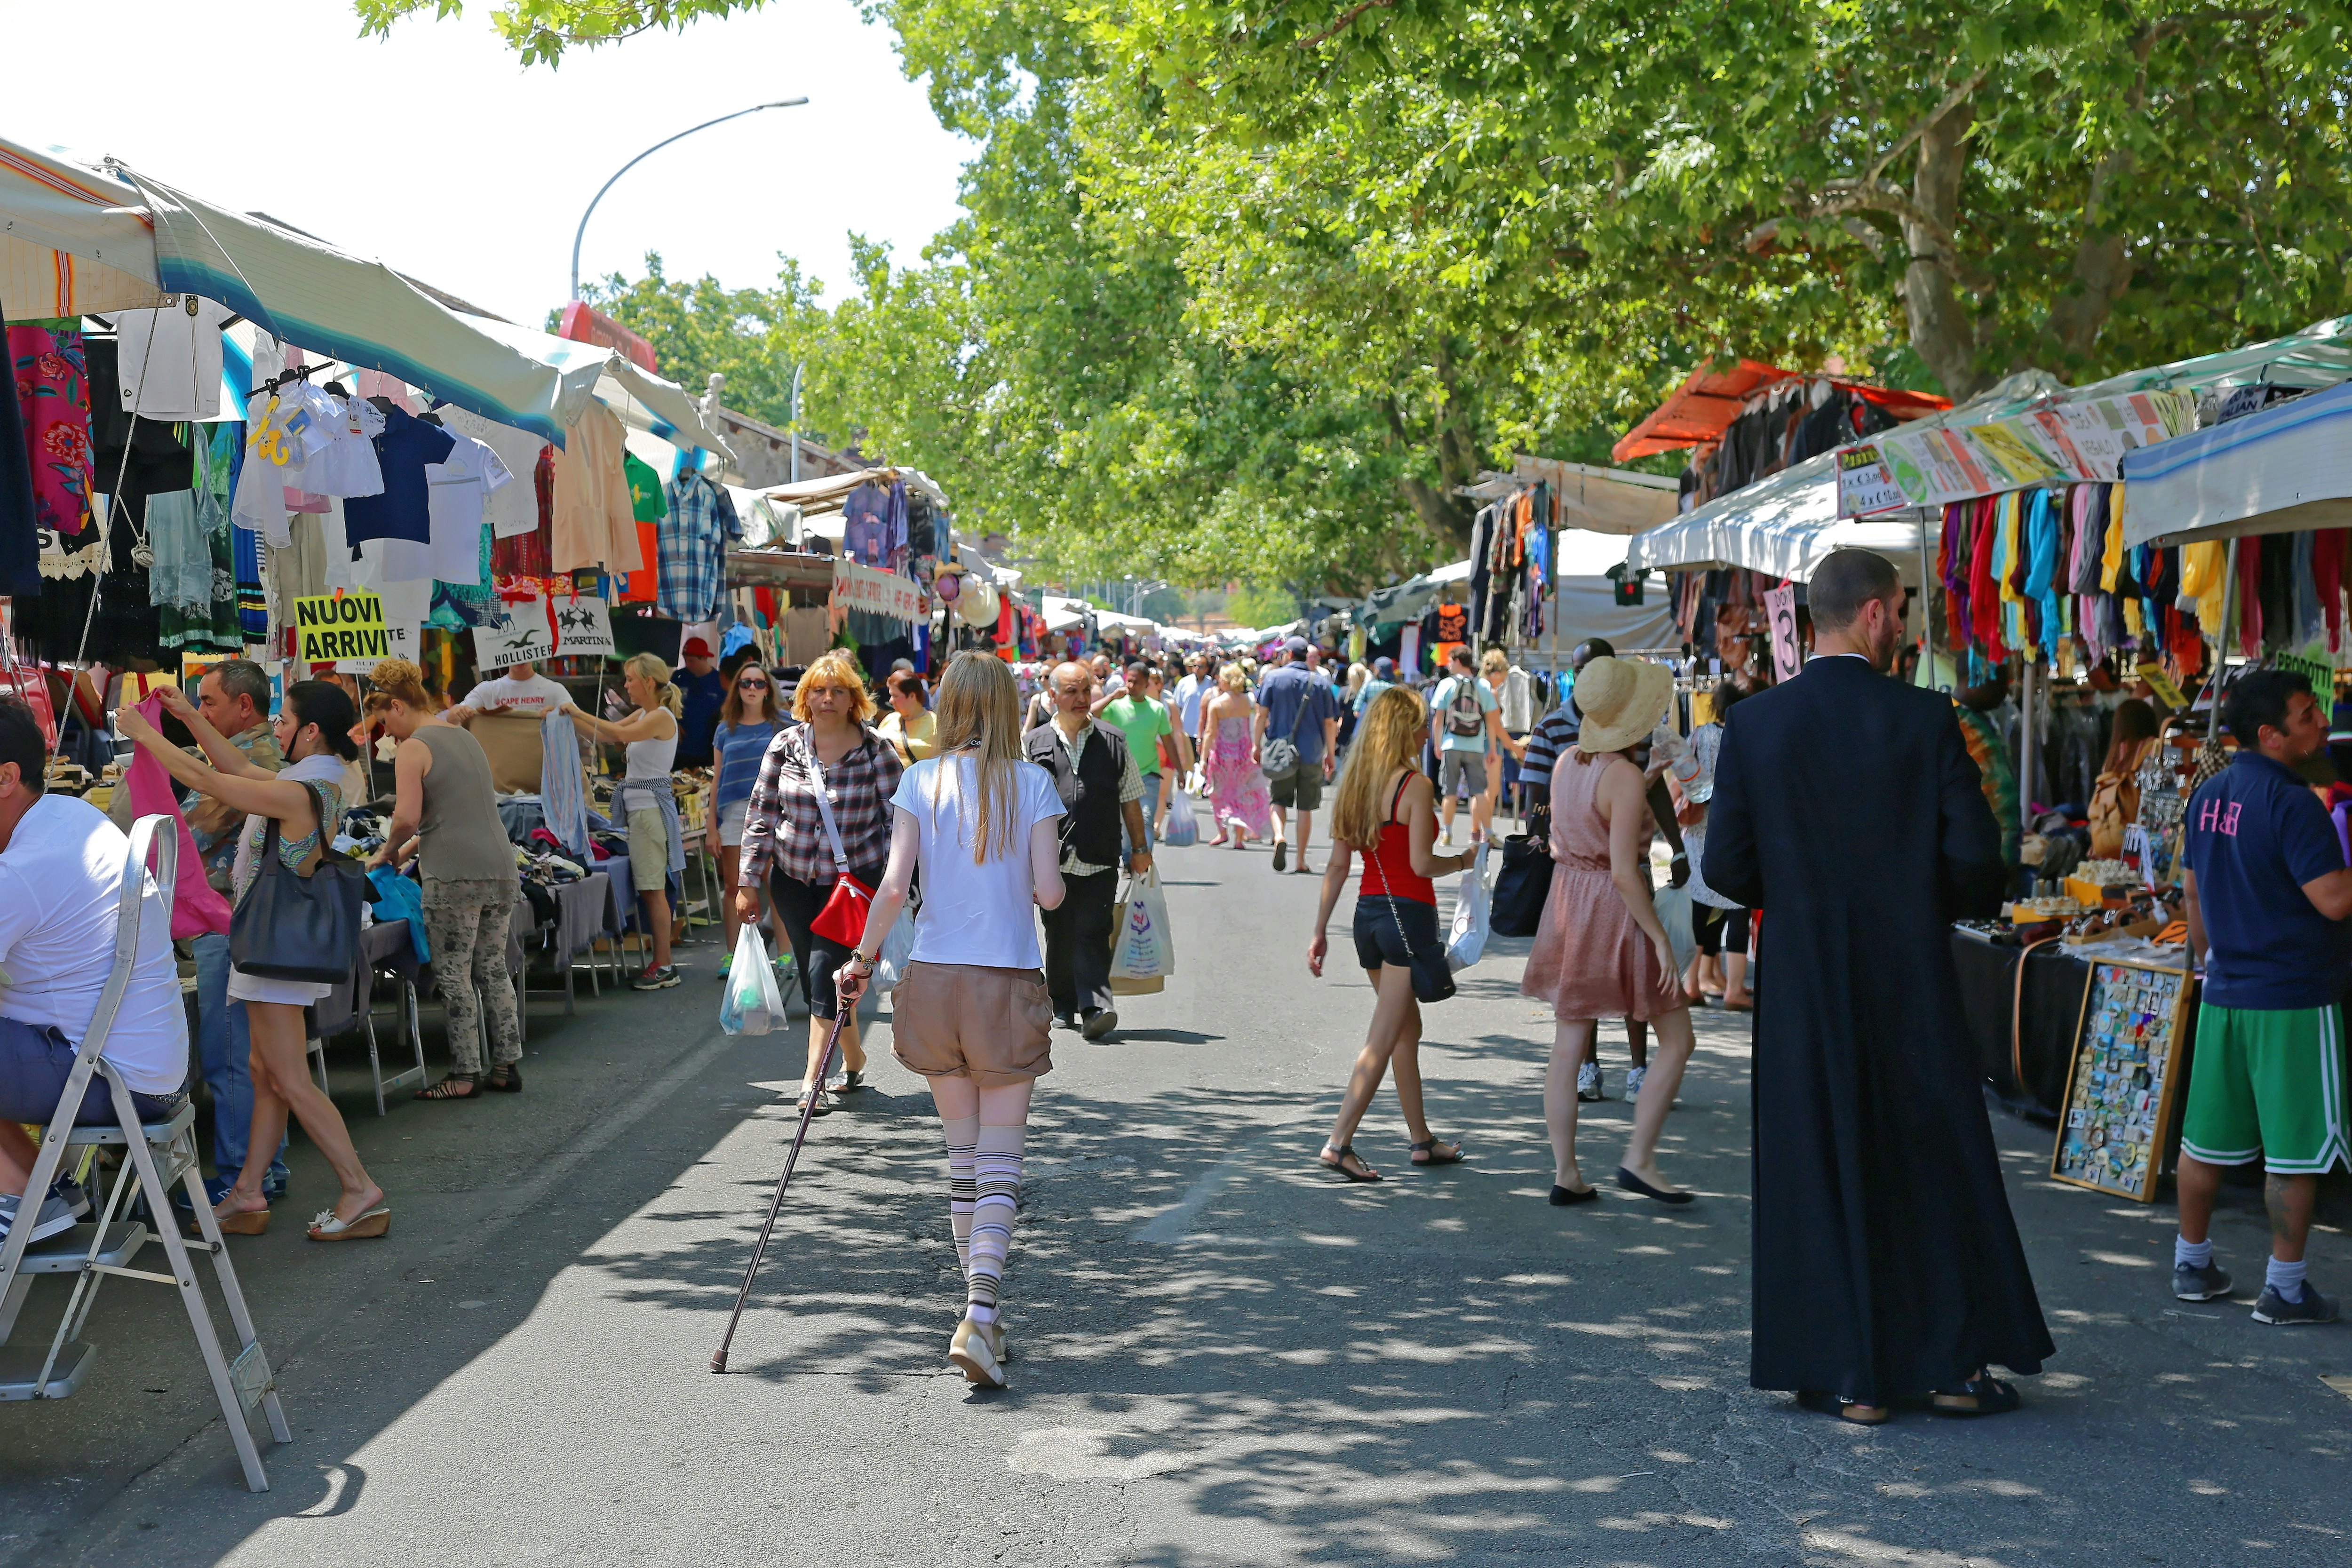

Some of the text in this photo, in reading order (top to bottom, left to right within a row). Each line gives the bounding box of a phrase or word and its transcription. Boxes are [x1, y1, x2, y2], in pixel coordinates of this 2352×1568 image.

[297, 597, 382, 626] NUOVI
[305, 629, 388, 660] ARRIVI
[1778, 610, 1795, 675] 3
